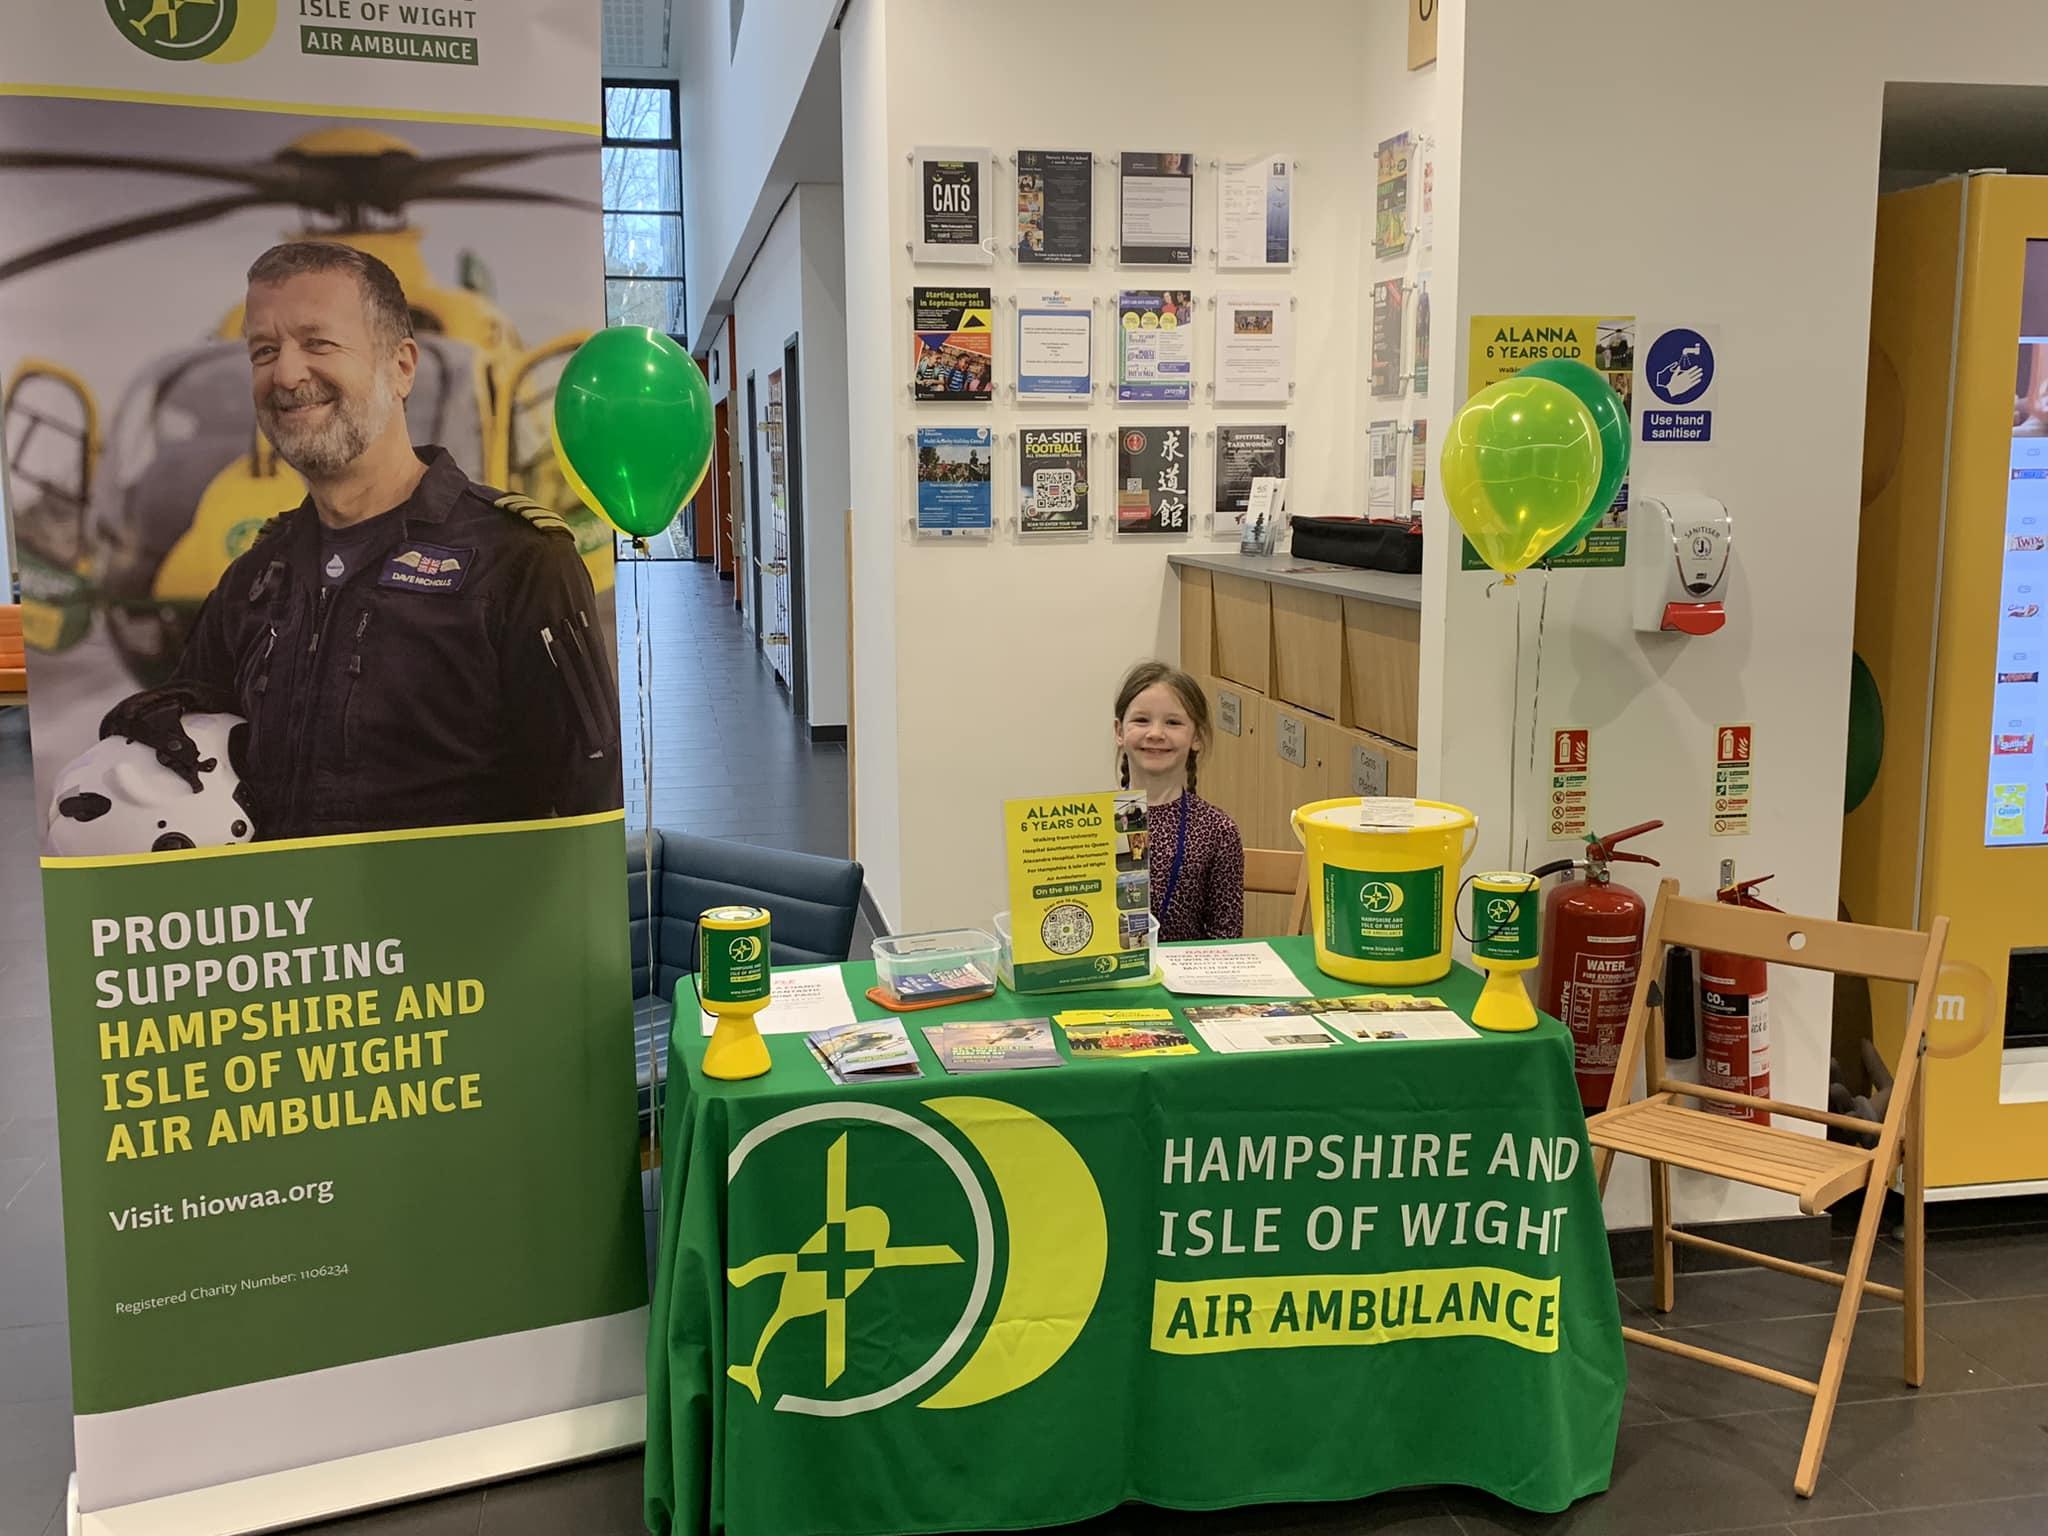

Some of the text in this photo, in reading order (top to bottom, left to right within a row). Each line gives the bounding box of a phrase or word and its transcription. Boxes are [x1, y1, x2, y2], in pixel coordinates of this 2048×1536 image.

[299, 0, 477, 29] ISLE OF WIGHT
[307, 31, 473, 60] AIR AMBULANCE
[933, 183, 970, 212] CATS
[926, 291, 955, 300] Starting
[929, 300, 967, 308] September
[1495, 327, 1578, 343] ALANNA
[1486, 346, 1581, 359] 6 YEARS OLD
[1499, 366, 1521, 374] Walki
[1650, 414, 1704, 425] Use hand
[1025, 432, 1082, 444] 6-A-SIDE
[1652, 427, 1701, 438] sanitiser
[1025, 444, 1082, 454] FOOTBALL
[392, 572, 415, 584] DAVE
[1027, 803, 1098, 819] ALANNA
[1021, 817, 1102, 832] 6 YEARS OLD
[1047, 844, 1083, 852] Southampton
[1080, 882, 1099, 892] April
[92, 897, 314, 957] PROUDLY
[95, 938, 404, 1009] SUPPORTING
[1587, 960, 1626, 972] WATER
[1935, 995, 1965, 1021] m
[98, 978, 486, 1060] HAMPSHIRE AND
[102, 1030, 449, 1112] ISLE OF WIGHT
[106, 1073, 482, 1162] AIR AMBULANCE
[1162, 1132, 1580, 1184] HAMPSHIRE AND
[109, 1180, 335, 1232] Visit hiowaa.org
[1156, 1201, 1568, 1256] ISLE OF WIGHT
[115, 1263, 349, 1315] Registered Charity Number: 1106234
[1166, 1281, 1555, 1339] AIR AMBULANCE
